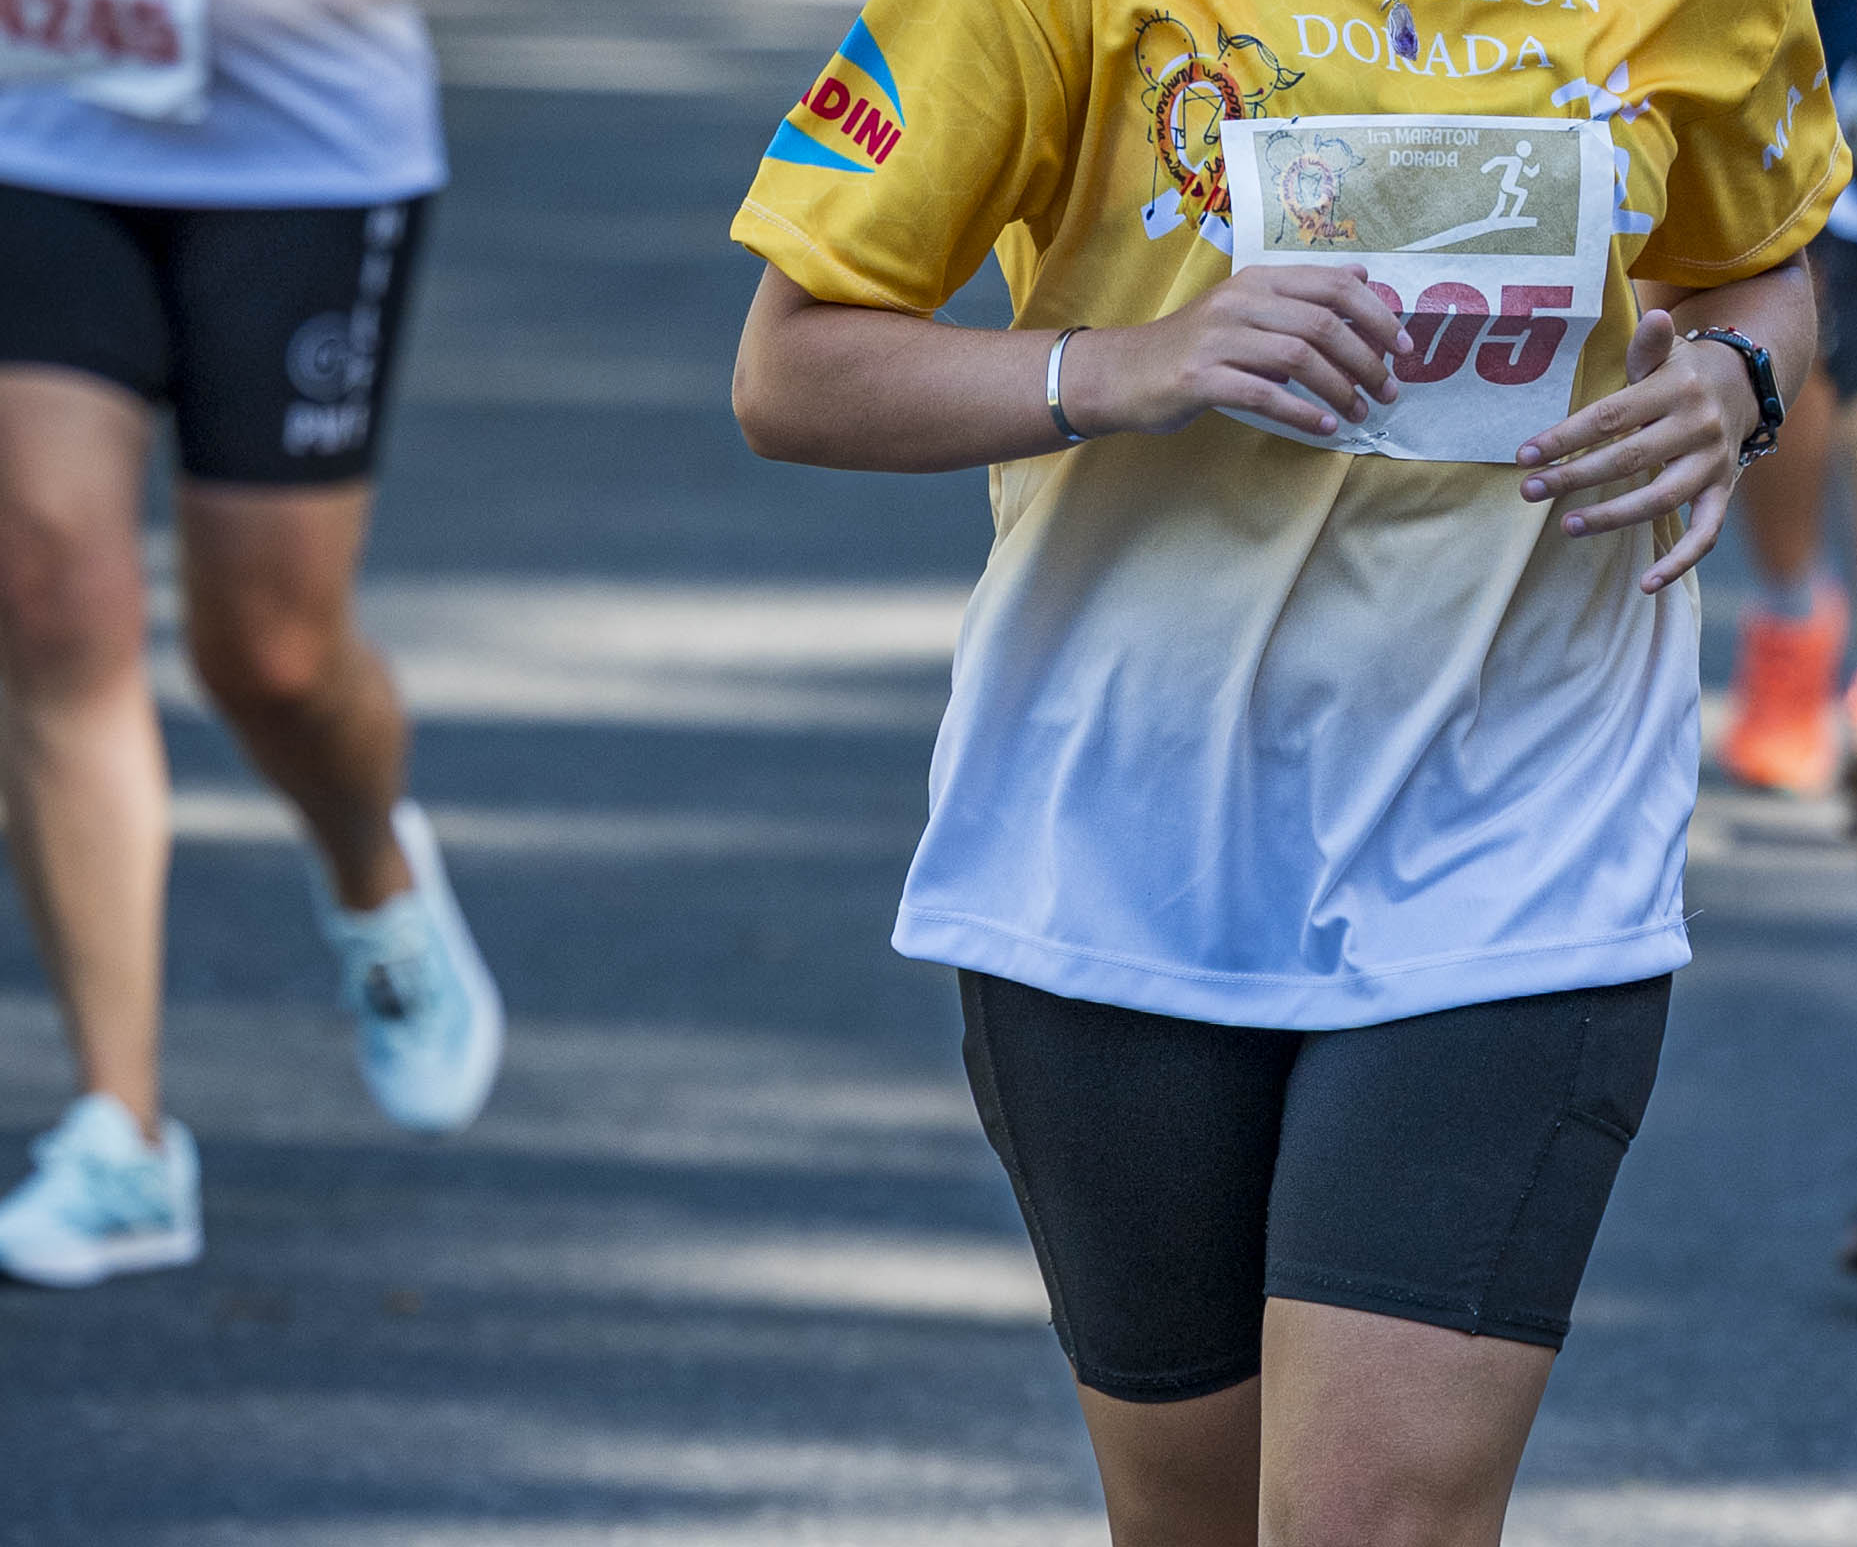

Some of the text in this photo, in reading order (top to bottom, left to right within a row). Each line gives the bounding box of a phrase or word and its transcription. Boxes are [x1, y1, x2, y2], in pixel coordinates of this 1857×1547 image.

[800, 76, 902, 165] DINI
[1388, 150, 1459, 168] DORADA
[1352, 281, 1574, 386] 05
